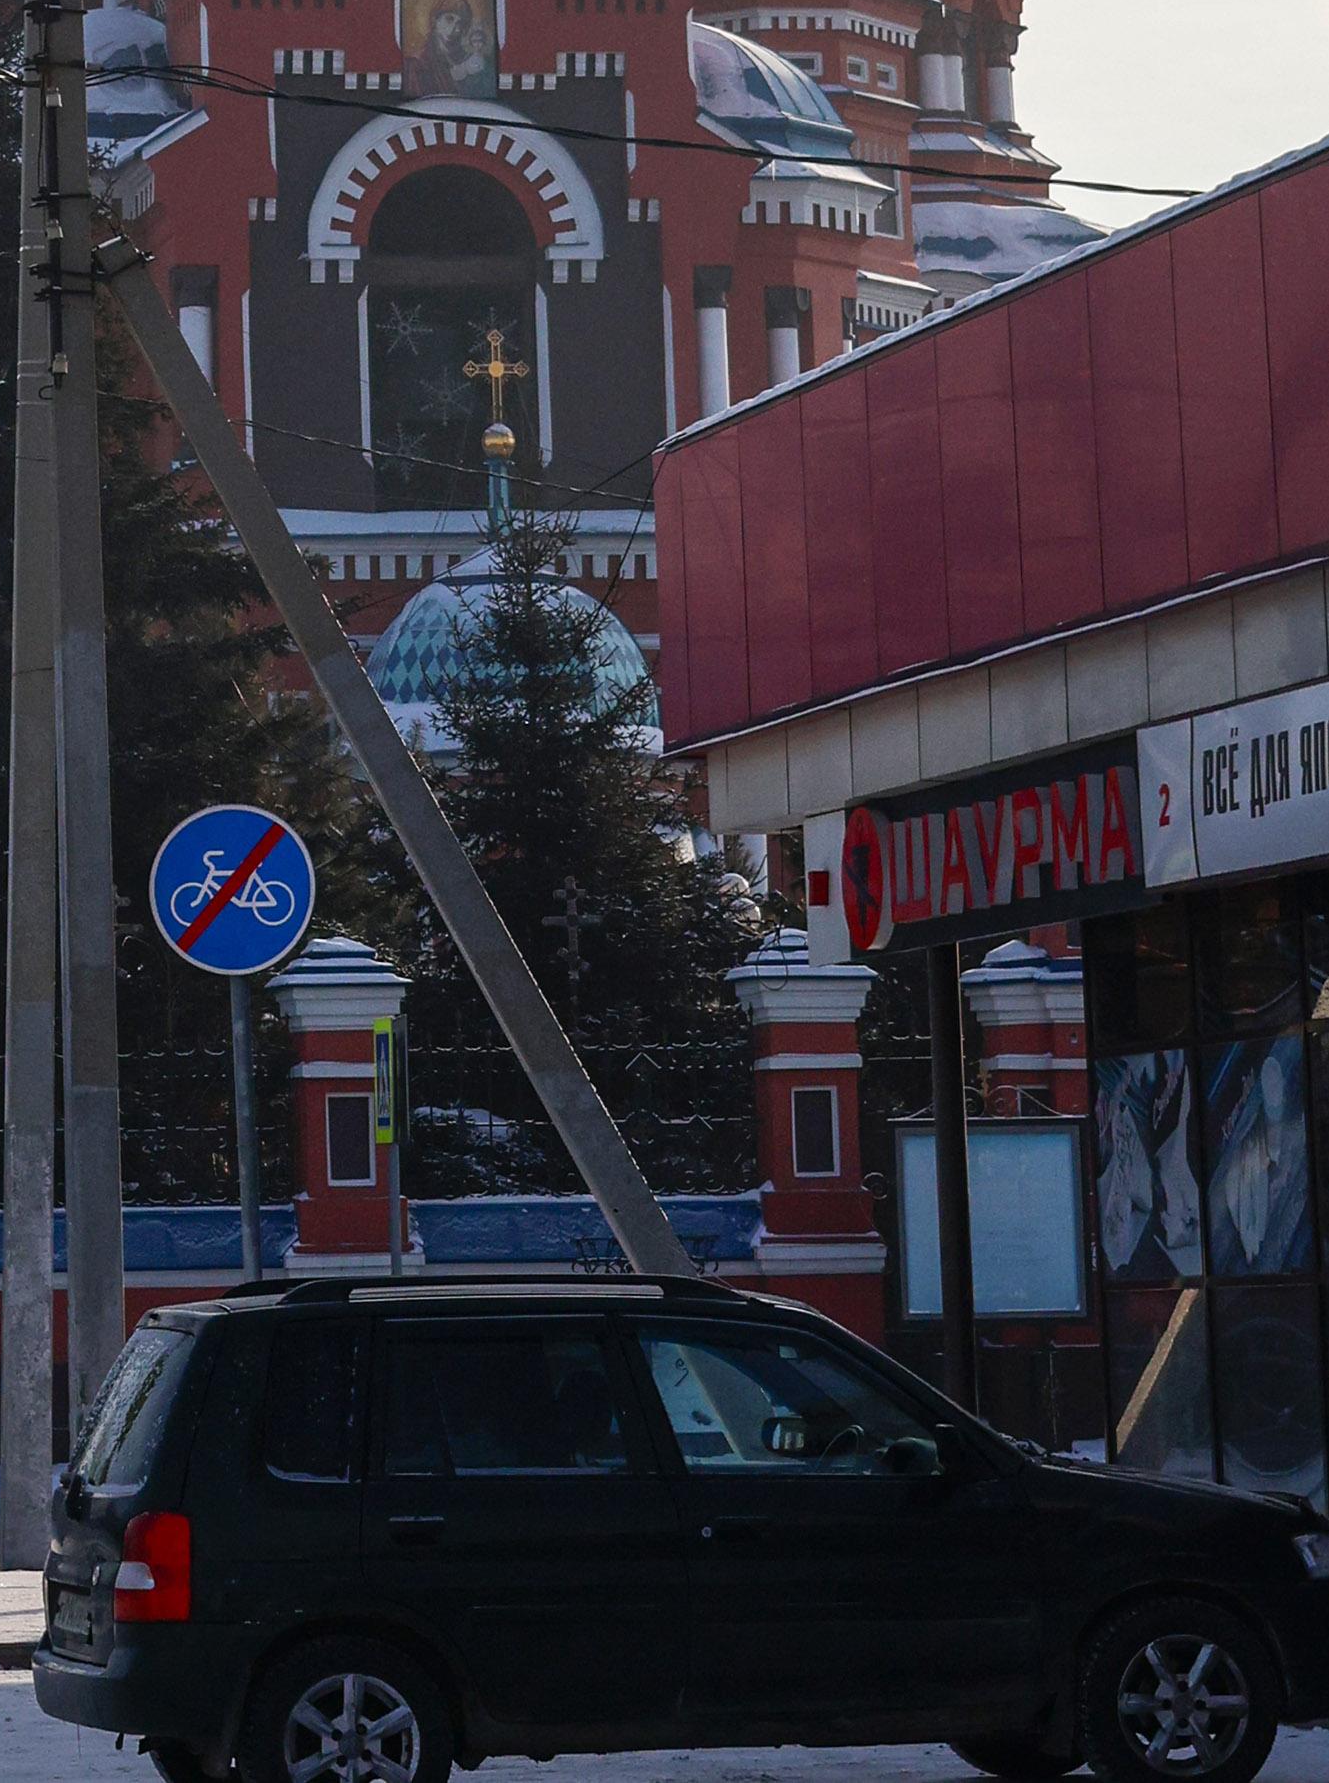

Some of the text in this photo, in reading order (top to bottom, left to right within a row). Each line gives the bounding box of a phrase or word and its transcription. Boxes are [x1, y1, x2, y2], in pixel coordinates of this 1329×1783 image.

[1202, 720, 1329, 818] ВСЁ ДЛЯ ЯП
[1159, 783, 1171, 827] 2
